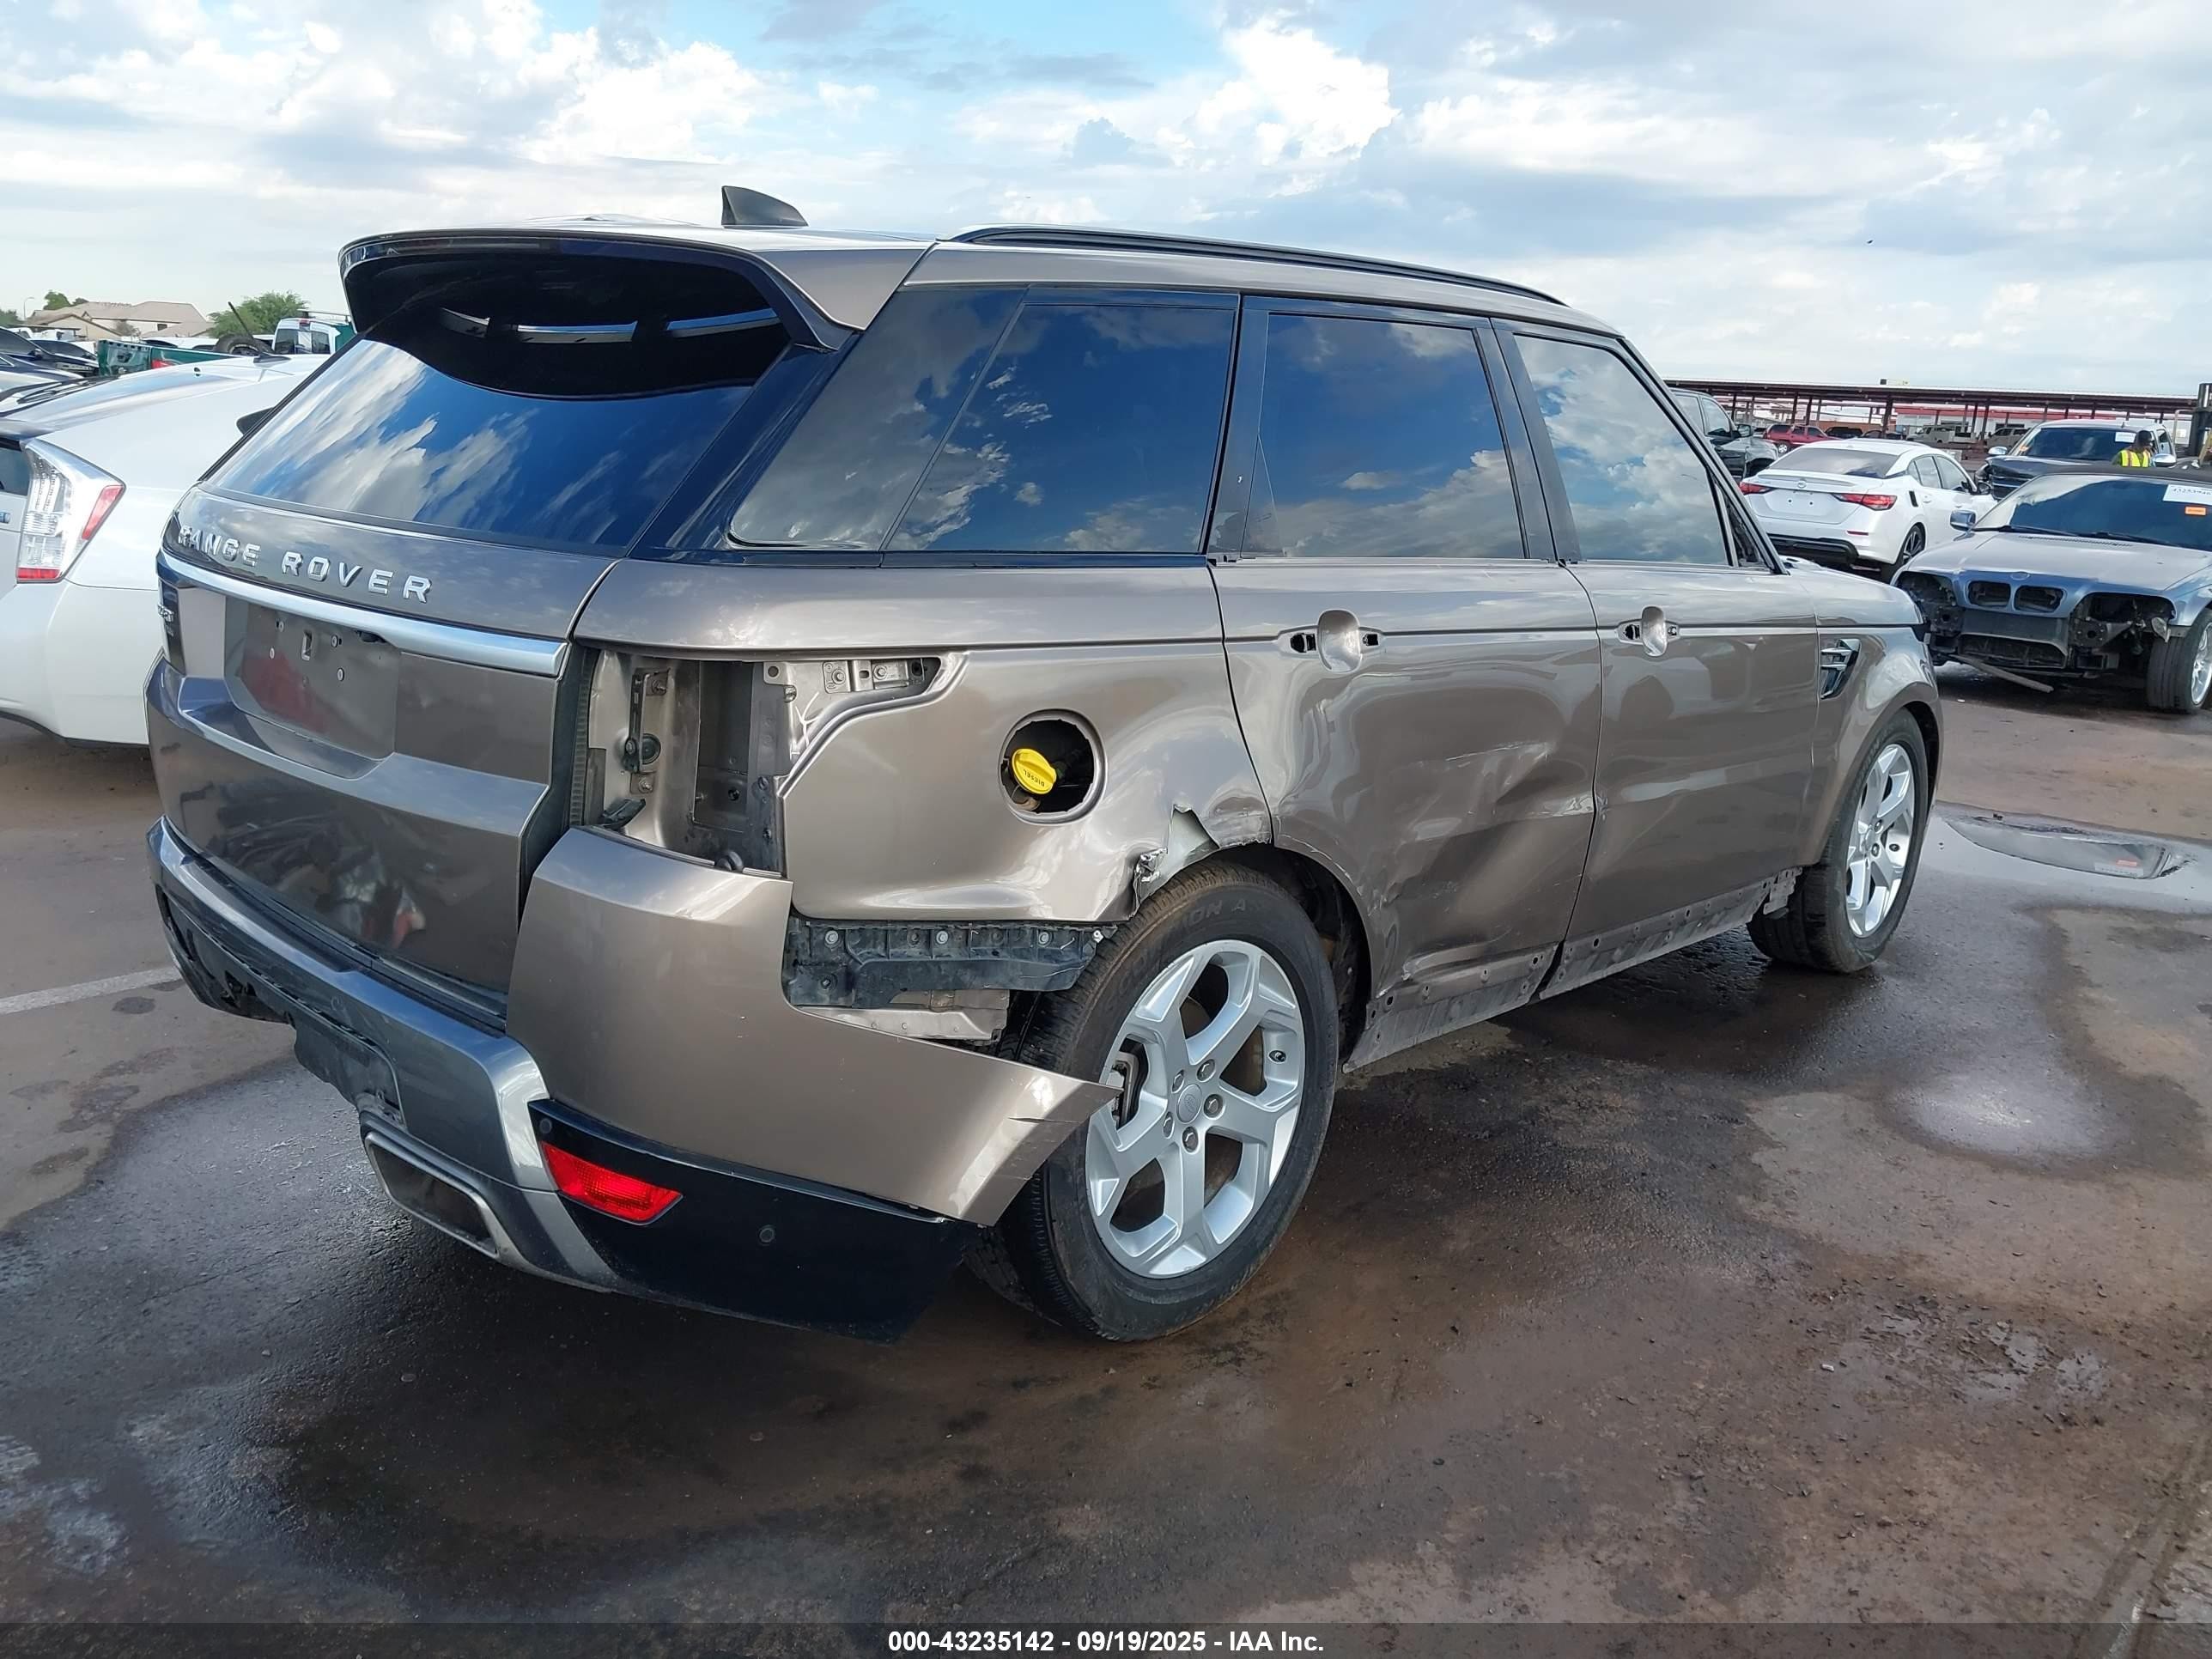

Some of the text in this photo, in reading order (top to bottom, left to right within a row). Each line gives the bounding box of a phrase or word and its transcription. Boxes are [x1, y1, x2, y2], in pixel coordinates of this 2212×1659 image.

[178, 525, 433, 603] RANGE ROVER
[1024, 769, 1045, 787] DIESEL
